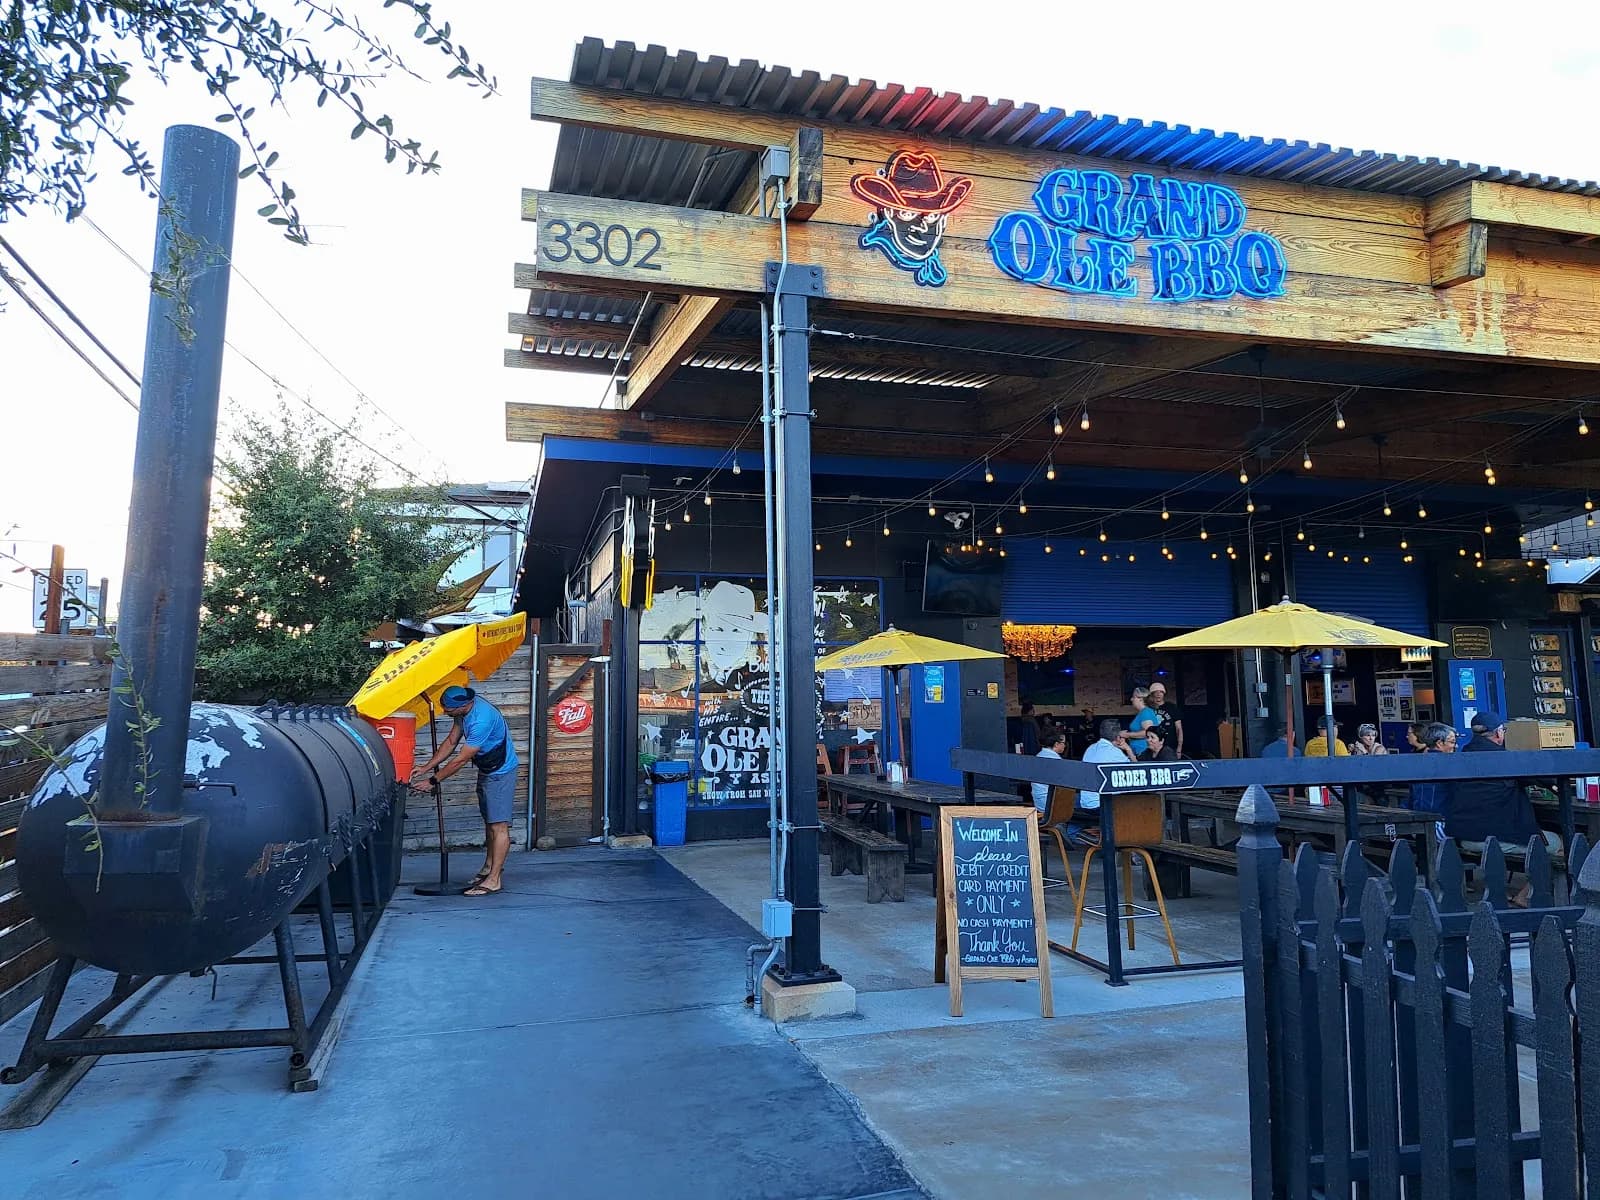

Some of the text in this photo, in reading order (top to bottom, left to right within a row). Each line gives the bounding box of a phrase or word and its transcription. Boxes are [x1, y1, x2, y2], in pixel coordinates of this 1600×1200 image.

[1032, 168, 1247, 239] GRAND
[543, 218, 661, 271] 3302
[989, 211, 1288, 302] OLE BBQ
[38, 575, 83, 586] SED
[558, 704, 588, 726] Fall
[700, 743, 760, 773] OLE
[729, 773, 742, 785] Y
[1111, 767, 1172, 788] ORDER BBQ
[726, 789, 746, 799] FROM
[748, 789, 762, 799] SAN
[956, 864, 985, 877] DEBIT
[996, 864, 1030, 877] CREDIT
[958, 880, 1028, 893] CARD PAYMENT
[976, 894, 1007, 914] ONLY
[957, 918, 969, 928] NO
[970, 918, 990, 928] CASH
[960, 928, 1030, 953] Thank You
